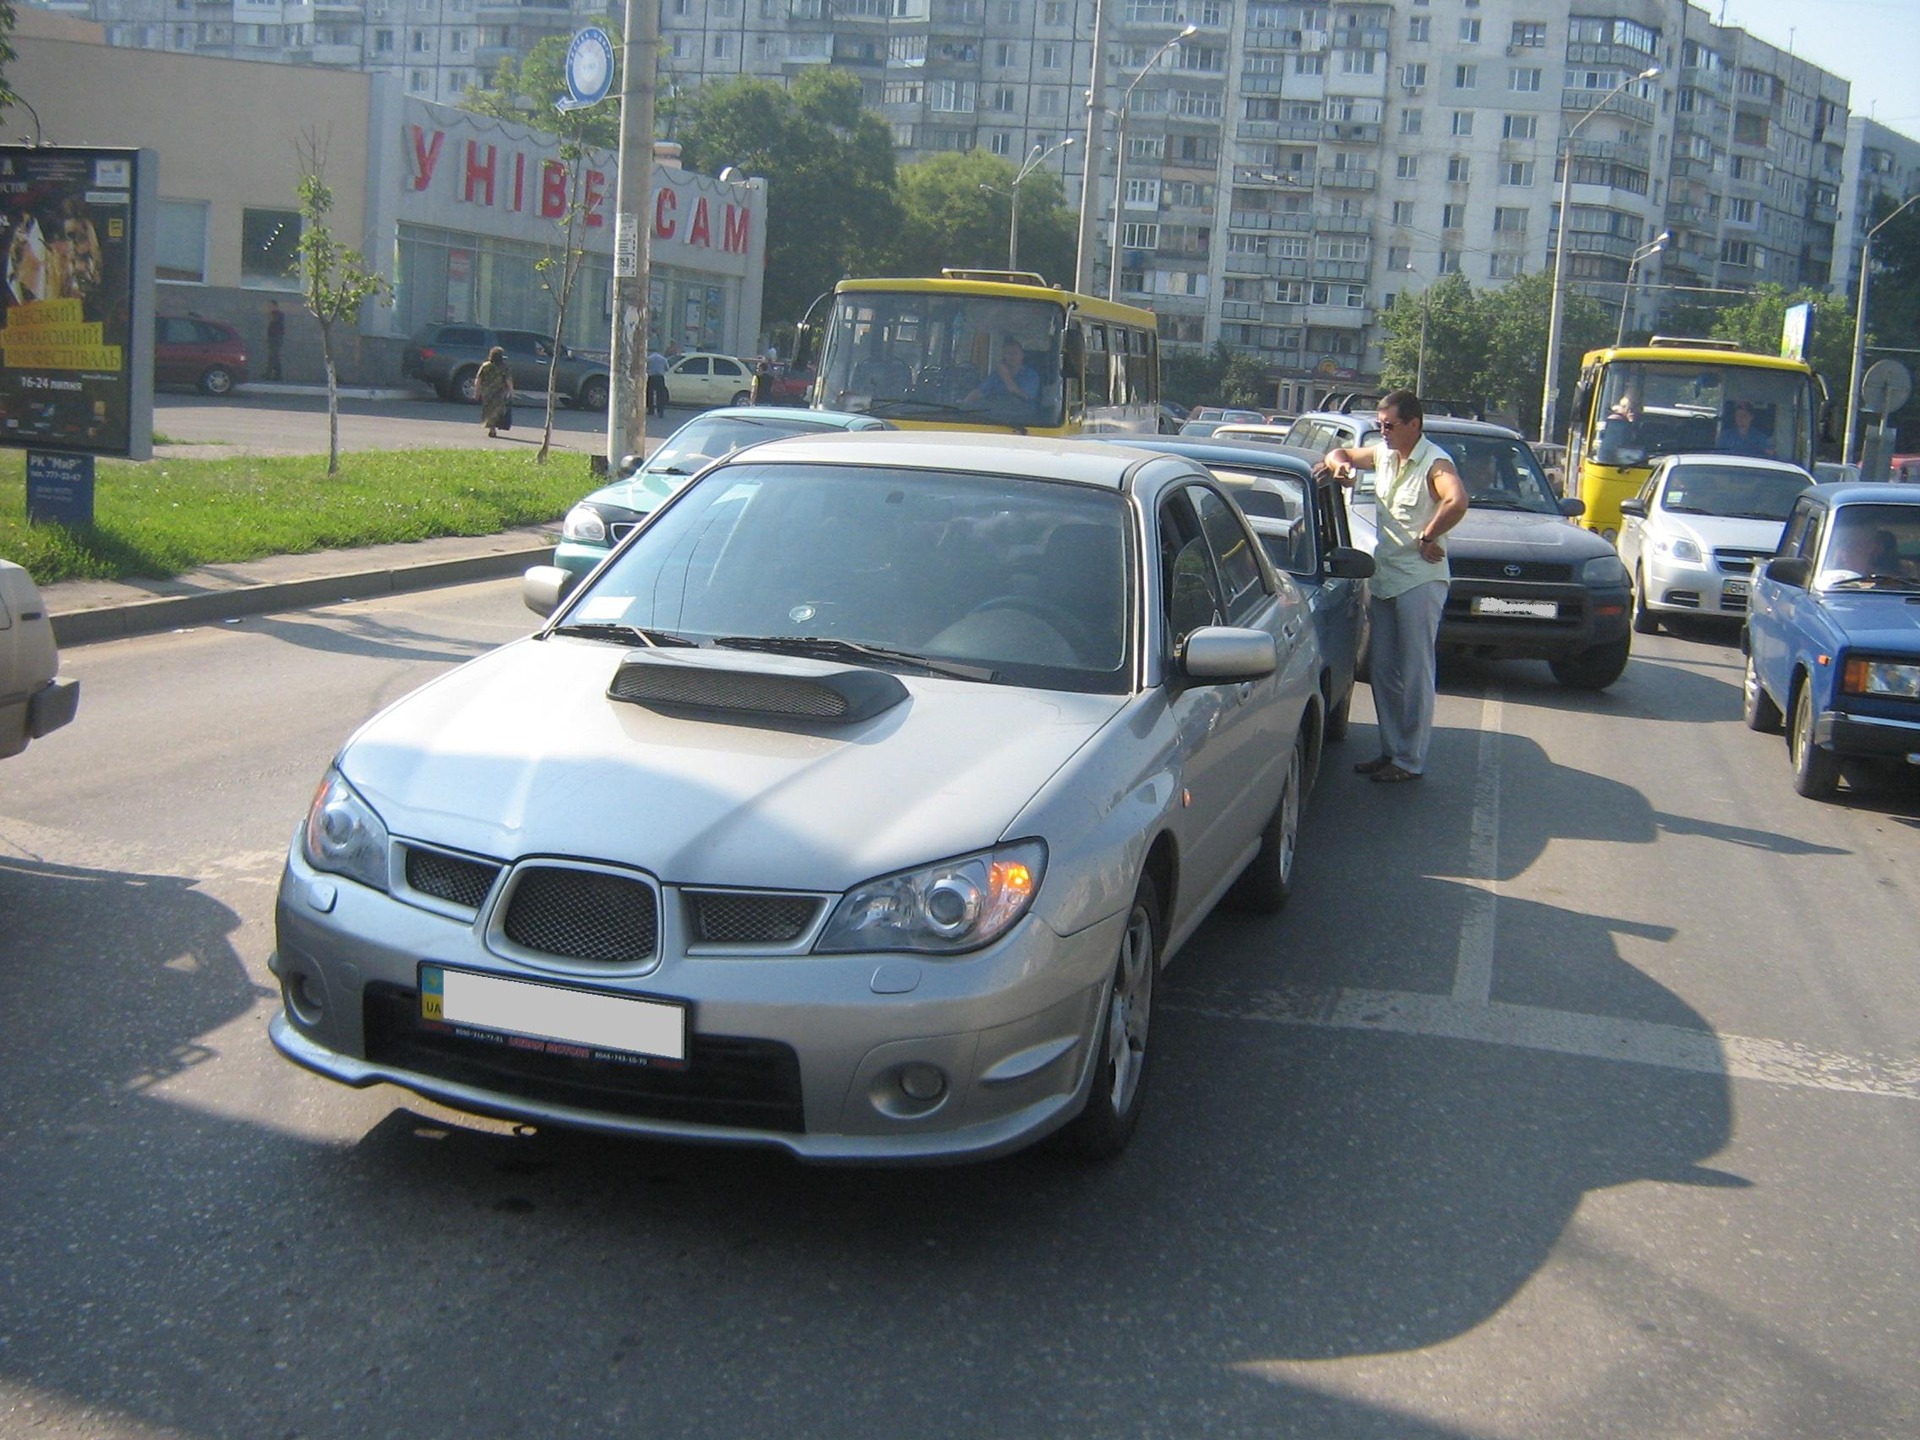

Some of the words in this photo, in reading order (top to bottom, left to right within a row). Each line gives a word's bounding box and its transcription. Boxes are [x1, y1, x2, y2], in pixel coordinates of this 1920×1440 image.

[411, 124, 750, 254] УНІВЕСАМ
[21, 376, 49, 389] 16-24
[426, 1001, 442, 1015] UA
